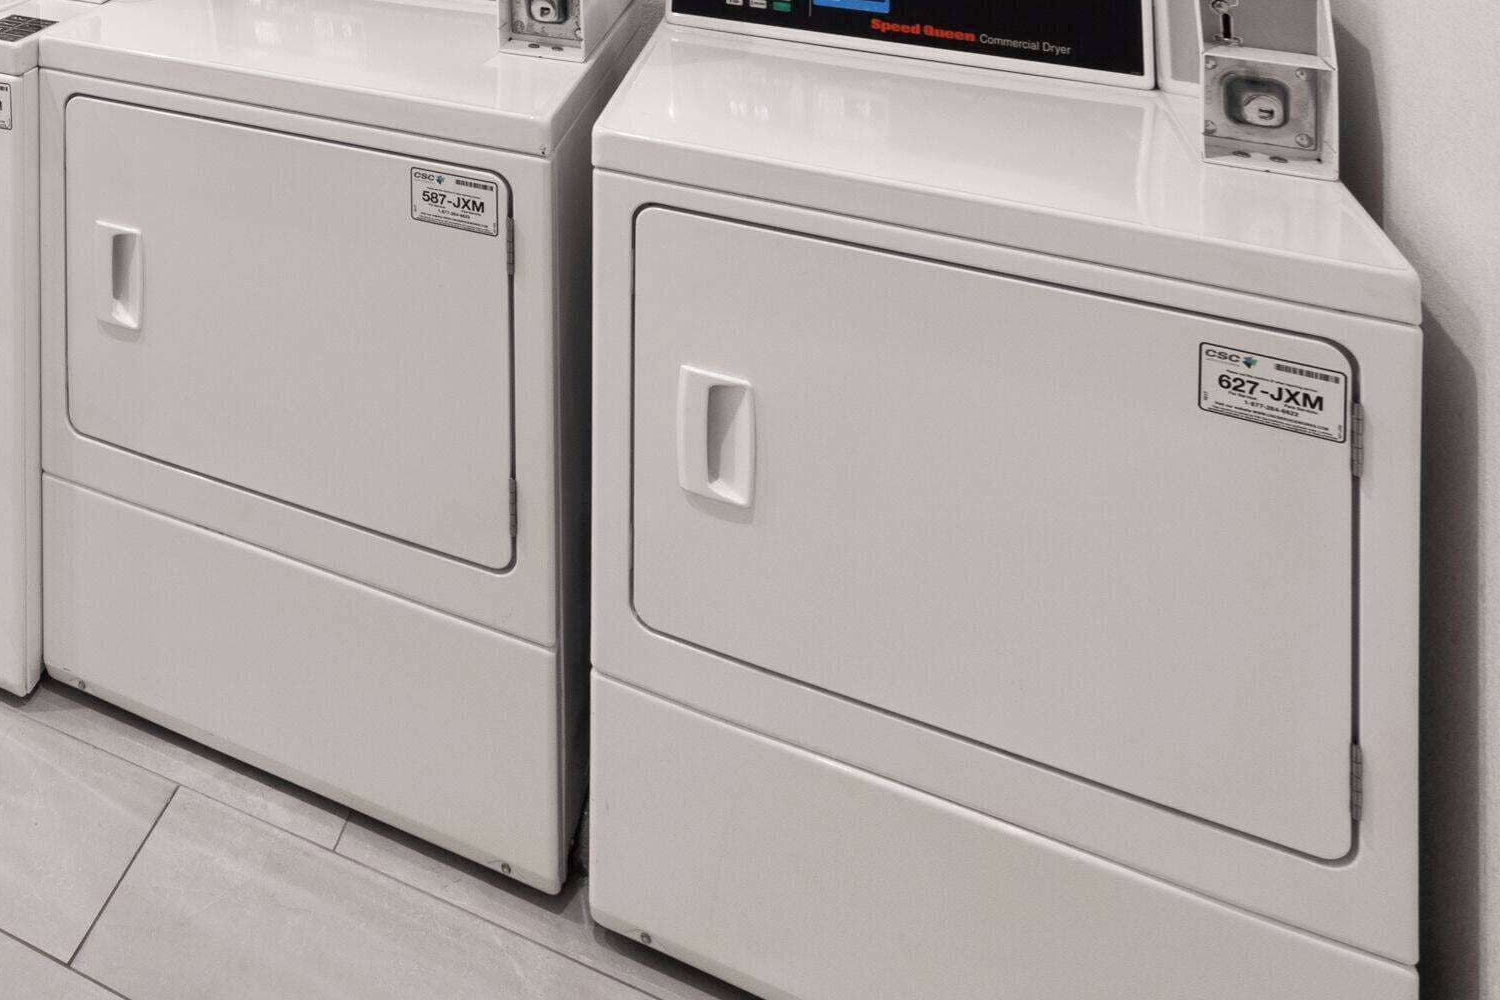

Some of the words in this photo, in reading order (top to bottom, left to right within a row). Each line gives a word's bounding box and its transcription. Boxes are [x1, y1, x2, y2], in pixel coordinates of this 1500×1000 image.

[870, 17, 920, 35] Speed
[923, 24, 976, 42] Queen
[979, 32, 1040, 51] Commercial
[1042, 40, 1072, 56] Dryer
[414, 171, 435, 181] CSC
[422, 190, 485, 213] 587-JXM
[1205, 349, 1241, 363] CSC
[1218, 374, 1324, 411] 627-JXM
